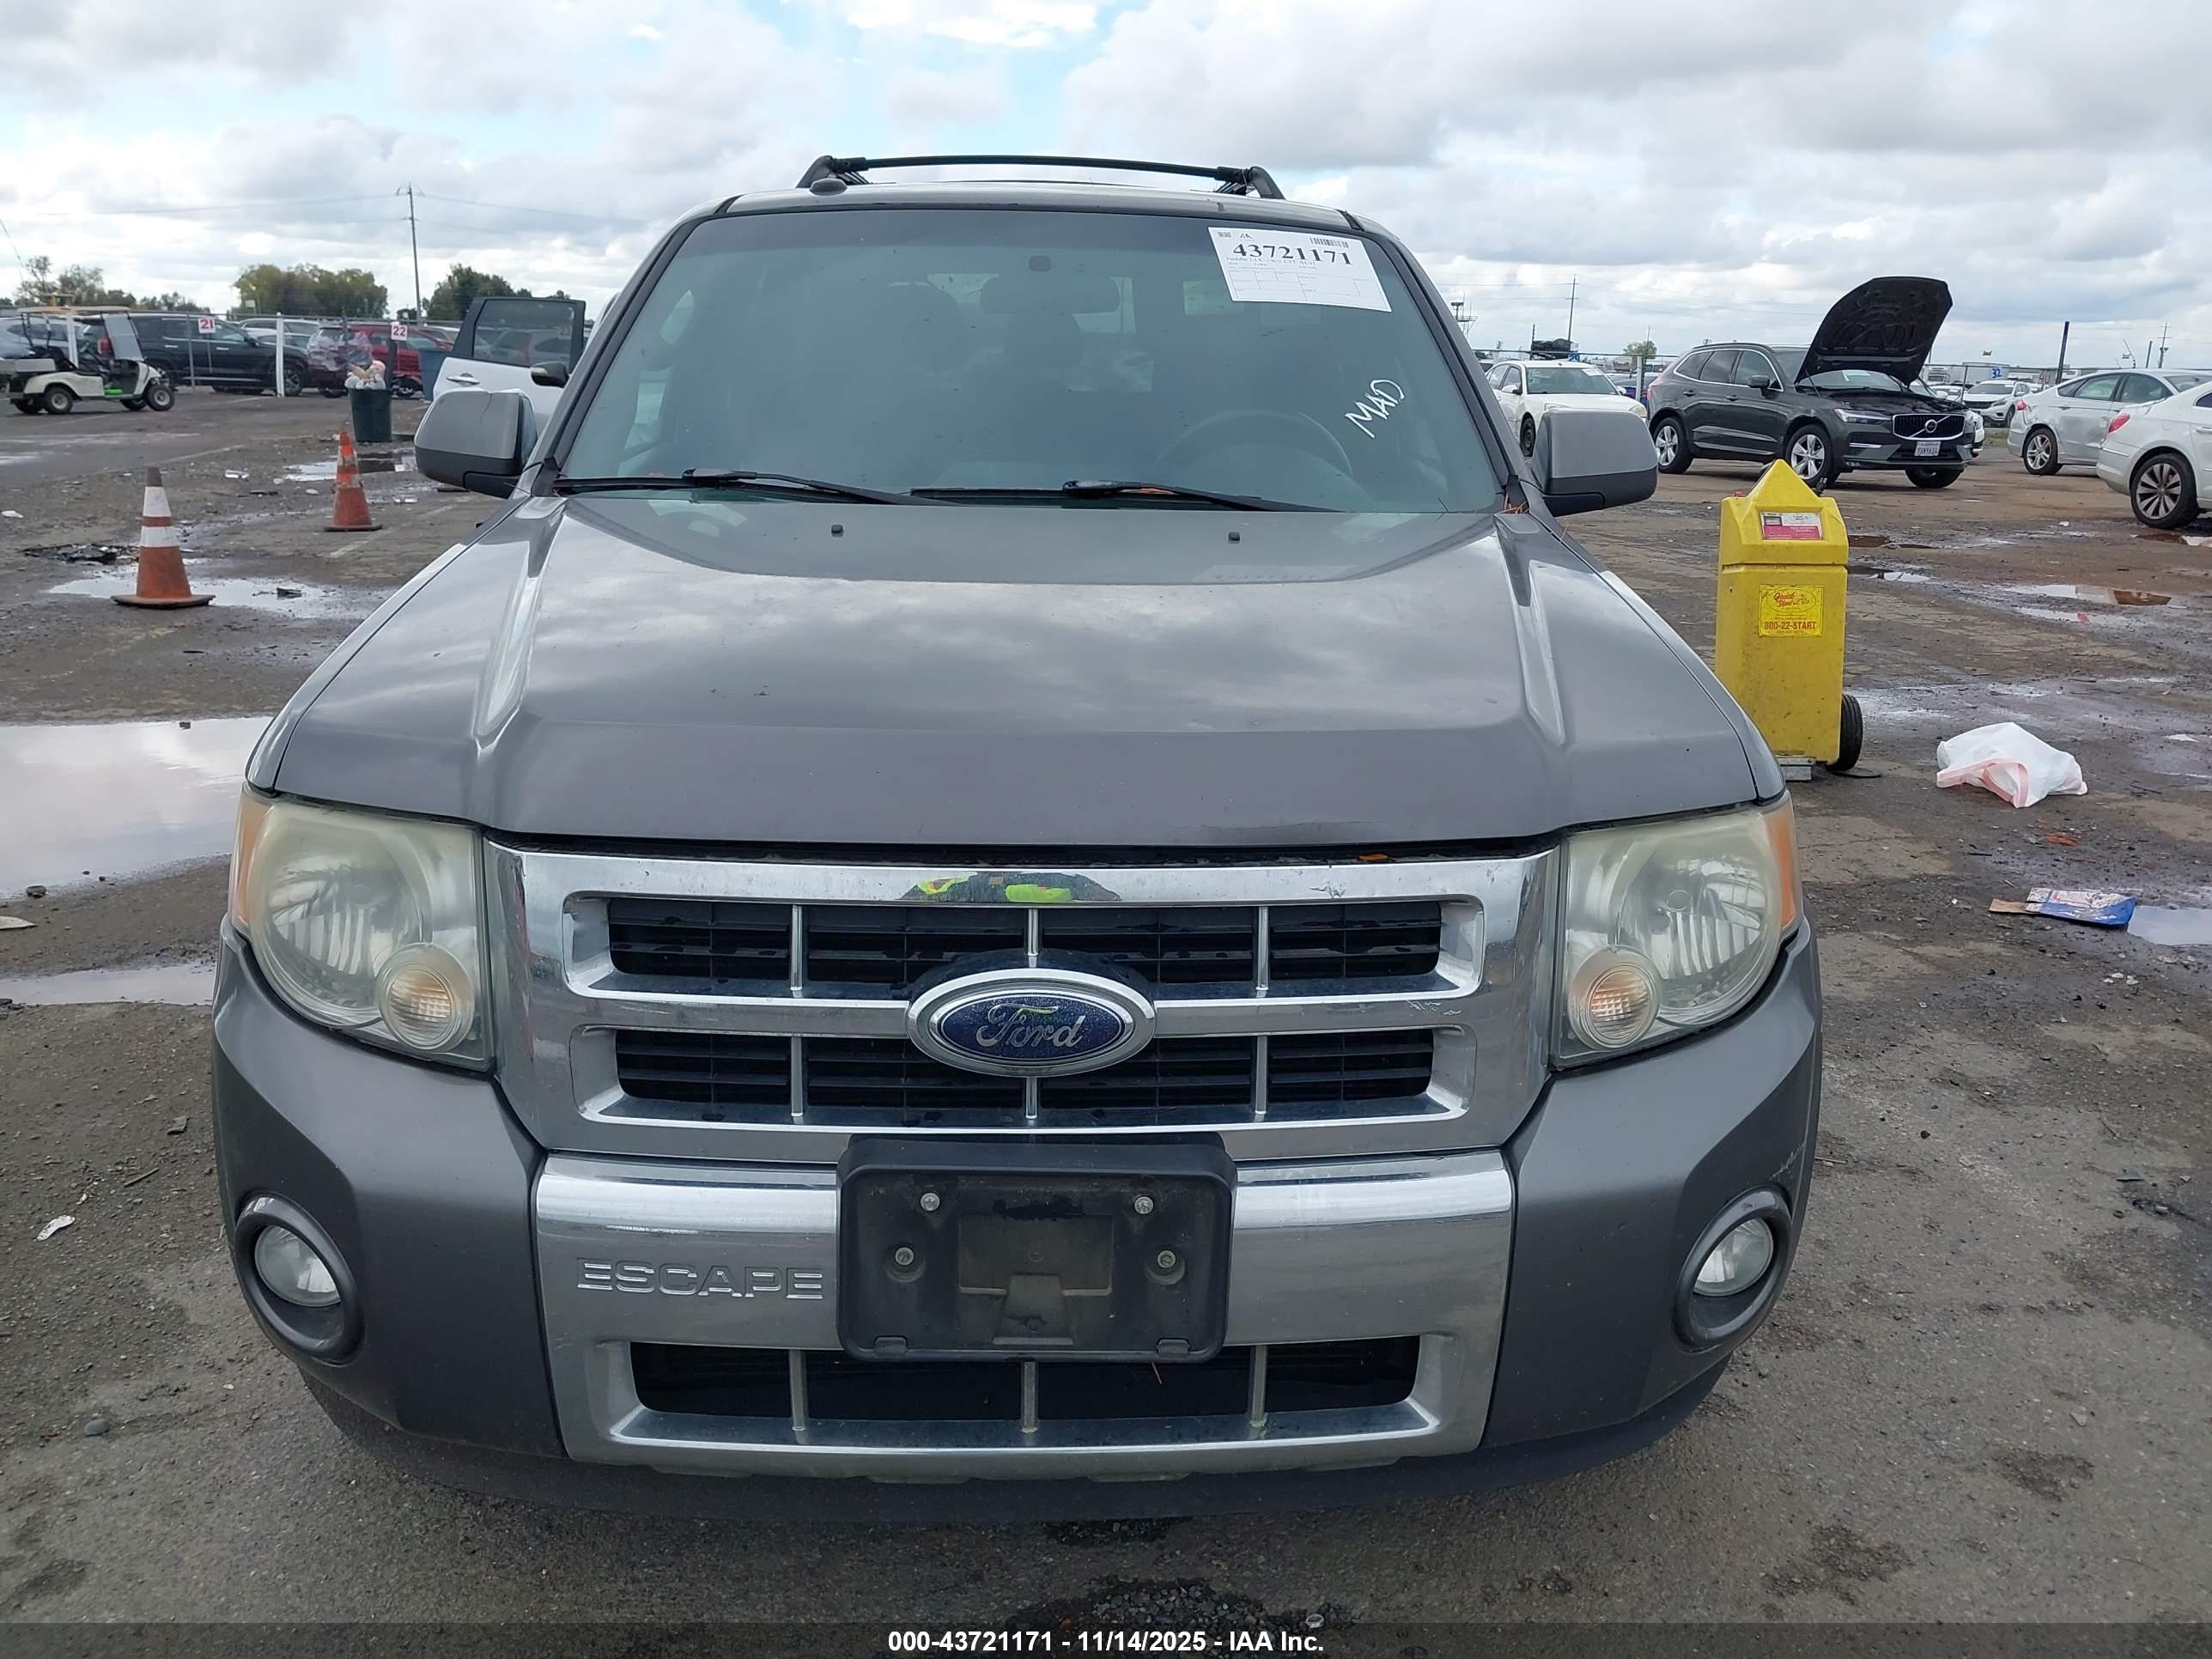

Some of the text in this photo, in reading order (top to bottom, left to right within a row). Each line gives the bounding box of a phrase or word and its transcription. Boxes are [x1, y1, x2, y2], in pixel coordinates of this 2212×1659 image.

[1233, 244, 1353, 265] 43721171
[200, 319, 214, 330] 21
[392, 326, 406, 337] 22
[1991, 368, 2002, 379] 32
[1345, 379, 1405, 439] MAD
[1765, 621, 1817, 630] 800-22-START
[975, 1003, 1085, 1047] Ford
[577, 1257, 823, 1299] ESCAPE
